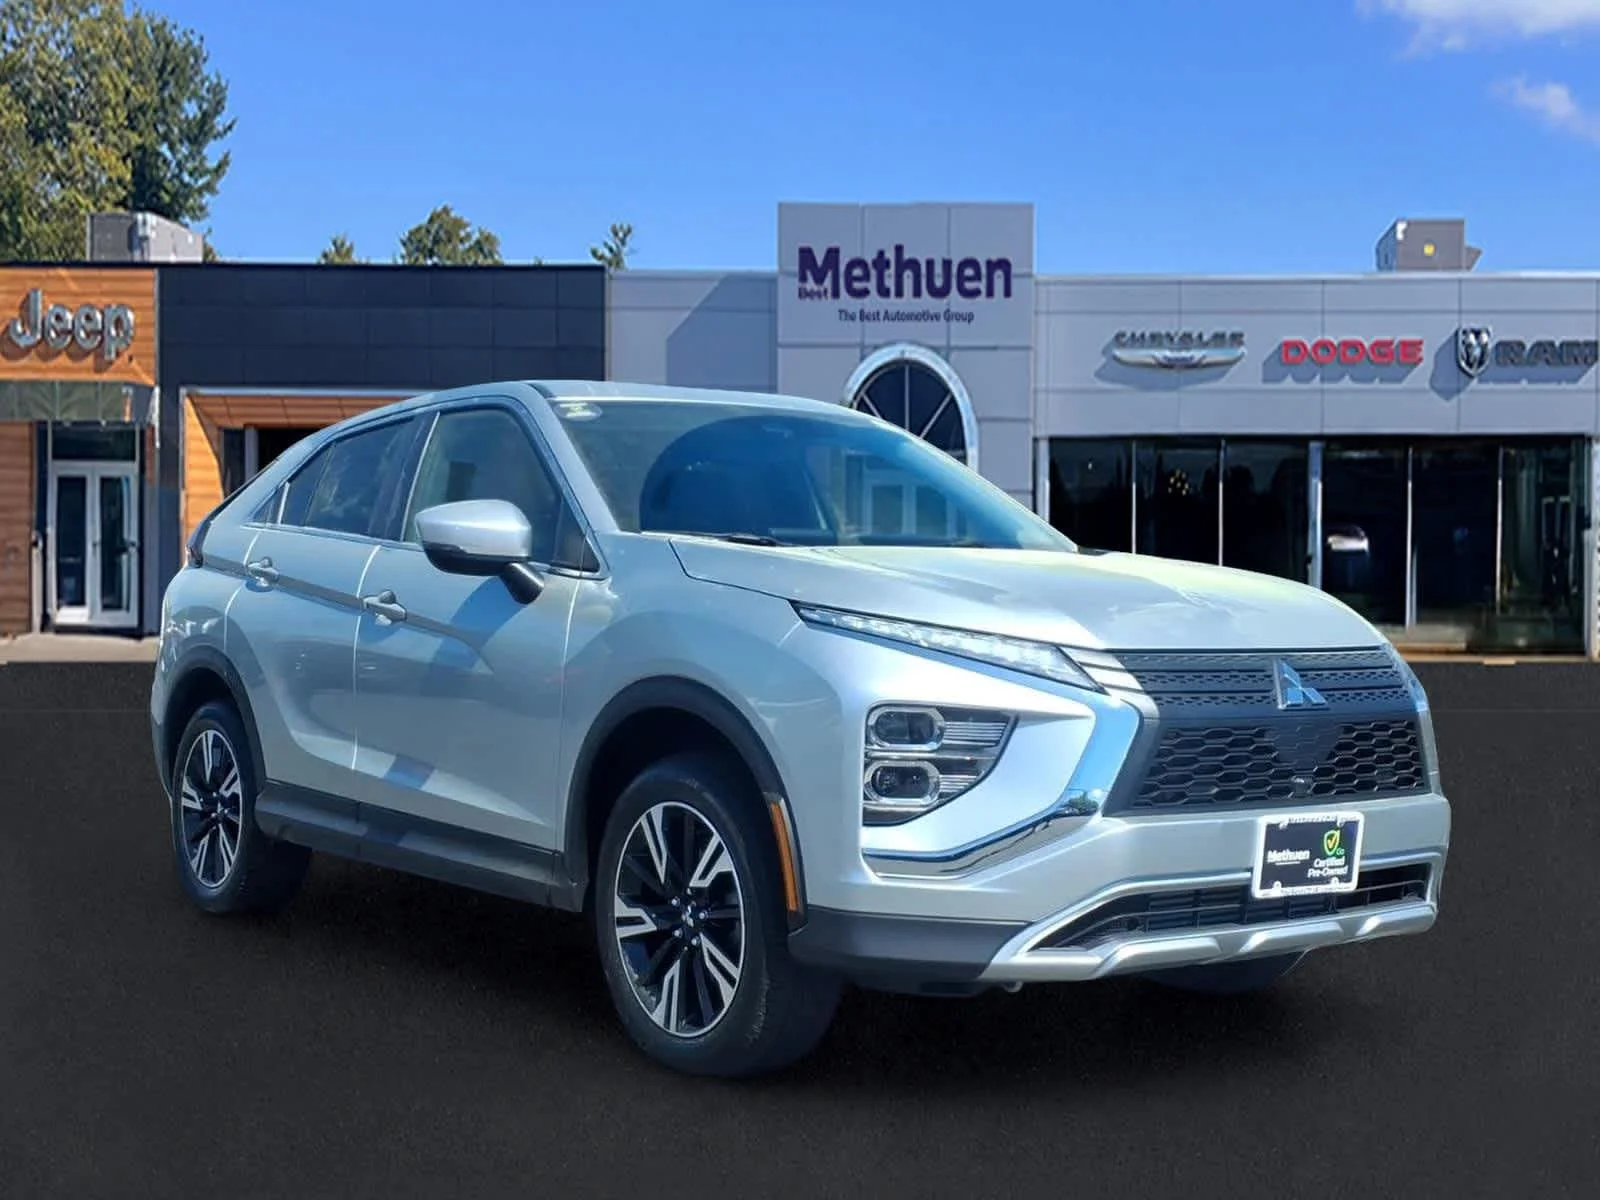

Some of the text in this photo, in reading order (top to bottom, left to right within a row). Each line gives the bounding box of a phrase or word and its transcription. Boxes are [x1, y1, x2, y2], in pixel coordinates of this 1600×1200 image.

[798, 244, 1012, 299] Methuen
[798, 286, 829, 300] Best
[9, 288, 135, 360] Jeep
[838, 309, 975, 324] The Best Automotive Group
[1113, 331, 1245, 347] CHRYSLER
[1281, 339, 1424, 363] DODGE
[1494, 340, 1598, 366] RAM
[1267, 849, 1310, 863] Methuen
[1313, 856, 1345, 868] Certified
[1307, 866, 1348, 878] Pre-Owned
